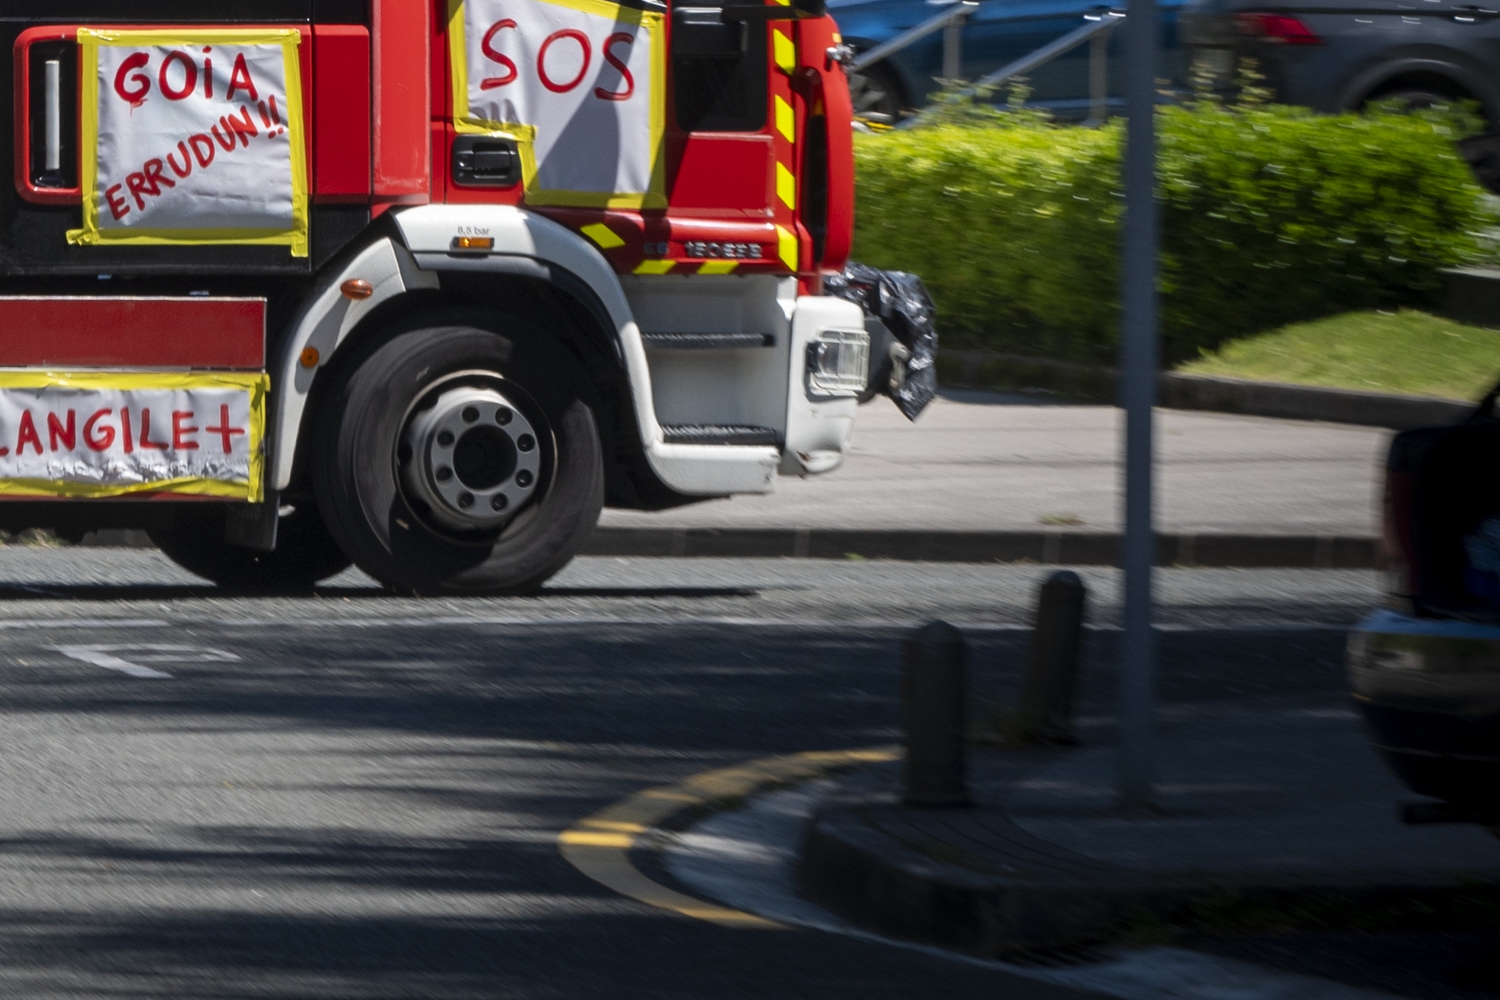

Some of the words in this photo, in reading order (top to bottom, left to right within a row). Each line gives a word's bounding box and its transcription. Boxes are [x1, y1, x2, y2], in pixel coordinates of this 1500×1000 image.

[479, 18, 635, 100] SOS
[104, 94, 284, 220] ERRUDUN!!
[474, 226, 490, 235] bar
